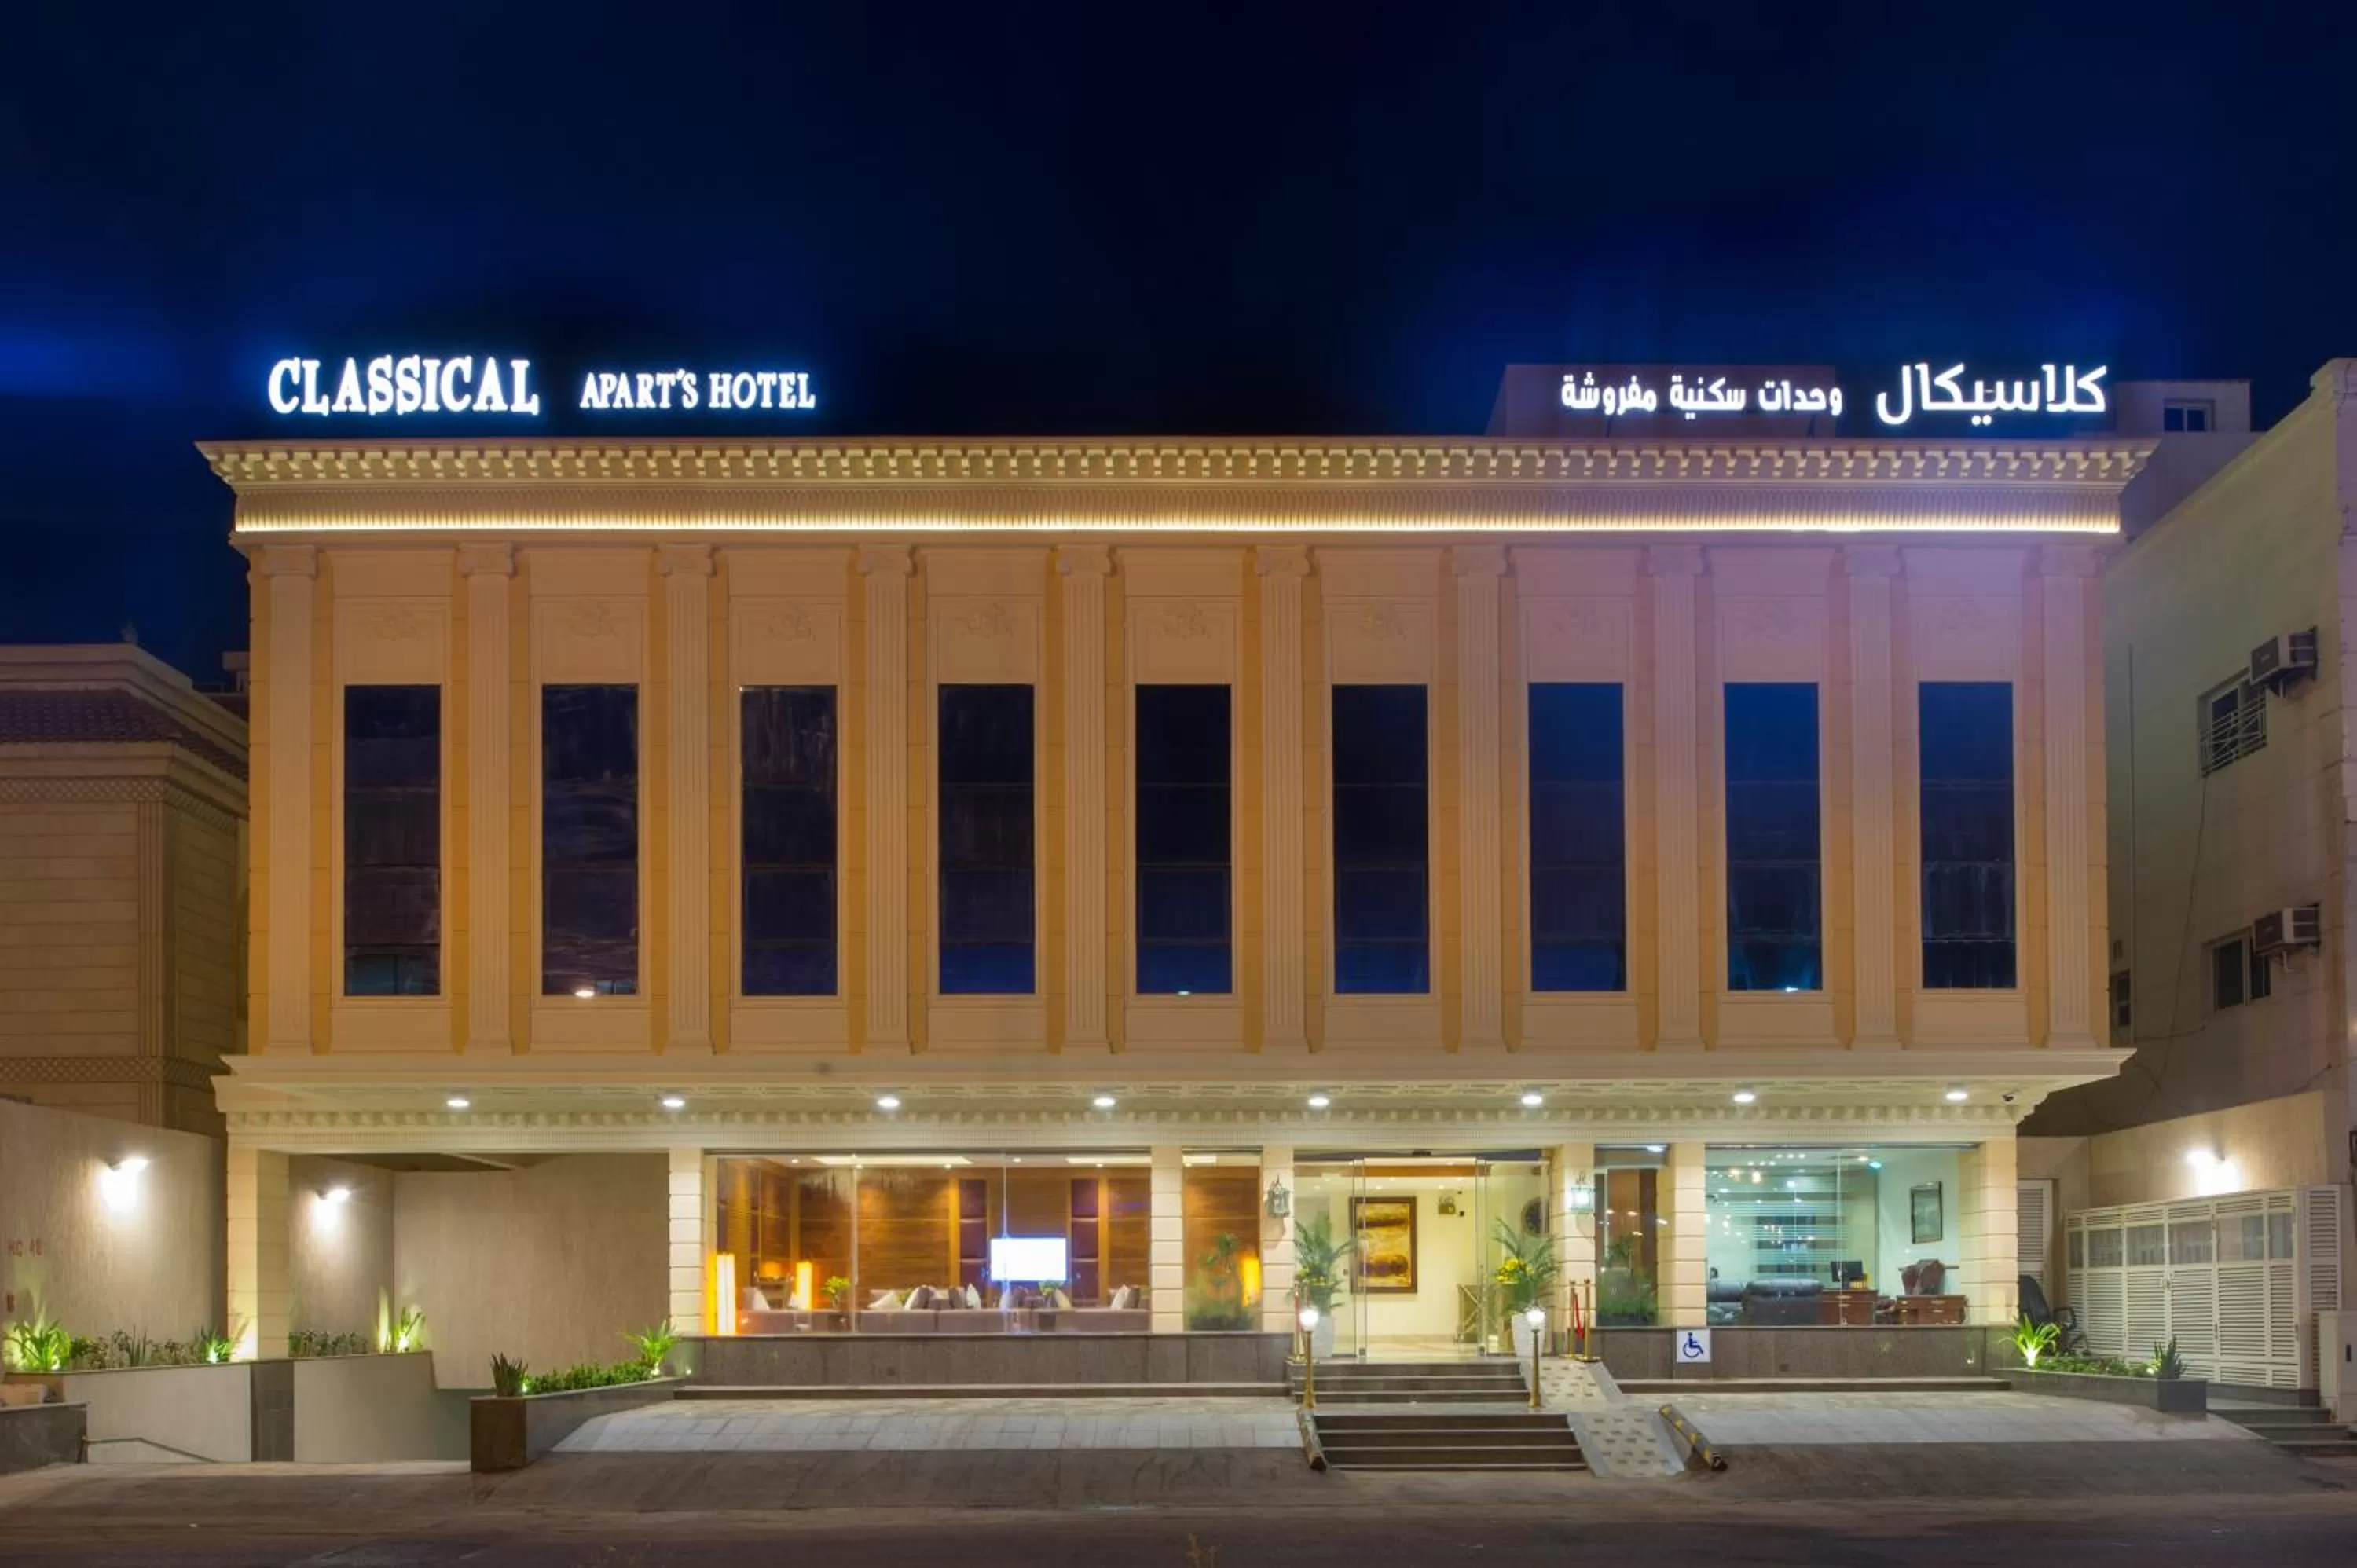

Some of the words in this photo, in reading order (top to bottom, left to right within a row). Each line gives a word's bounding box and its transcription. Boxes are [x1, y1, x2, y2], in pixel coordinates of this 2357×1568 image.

[267, 354, 539, 416] CLASSICAL
[578, 368, 698, 409] APART'S
[708, 372, 816, 409] HOTEL
[1560, 371, 1657, 416] مفروشة
[1669, 374, 1746, 420] سكنية
[1757, 379, 1842, 416] وحدات
[1876, 362, 2106, 425] كلاسيكال
